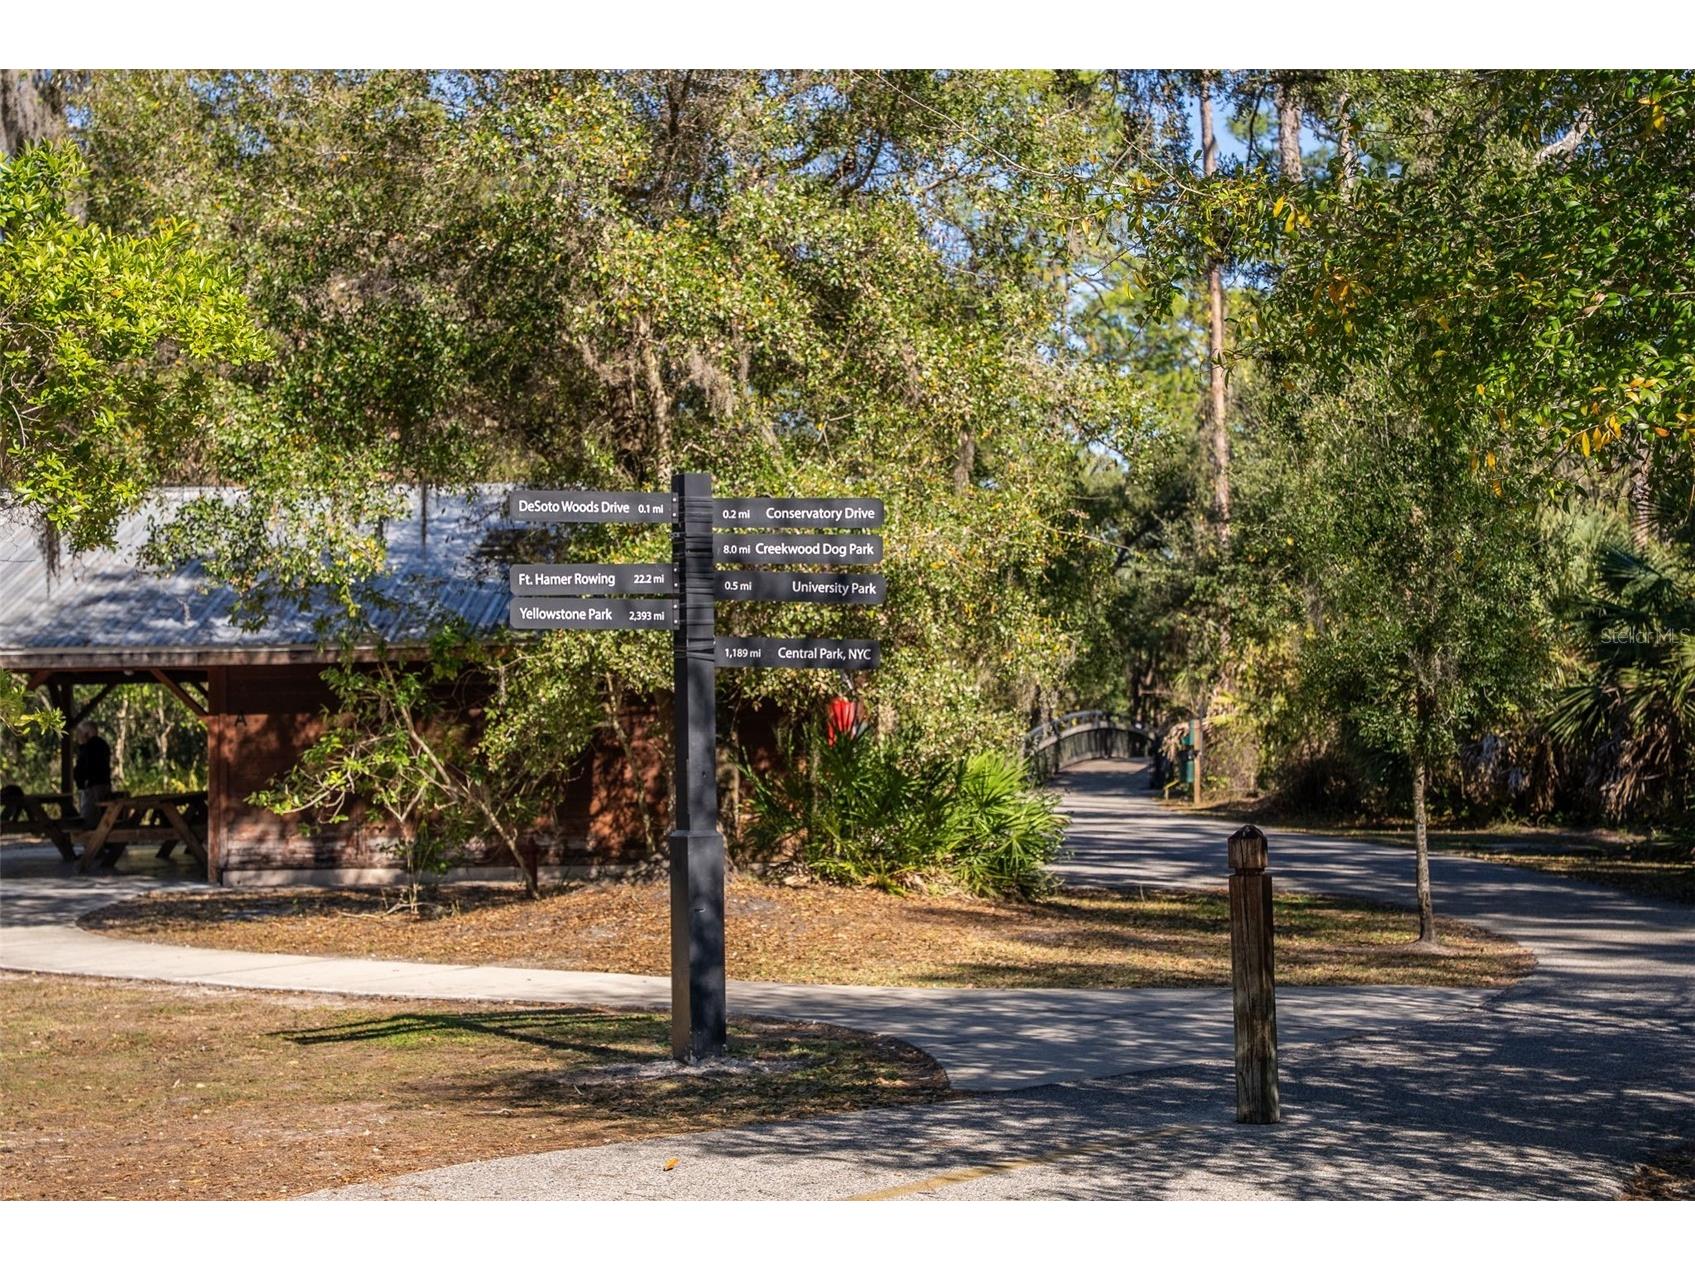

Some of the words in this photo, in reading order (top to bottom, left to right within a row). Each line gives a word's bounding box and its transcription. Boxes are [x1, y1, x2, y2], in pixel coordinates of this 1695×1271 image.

[518, 499, 561, 513] DeSoto
[560, 500, 600, 513] Woods
[600, 500, 630, 514] Drive
[637, 503, 651, 514] 0.1
[652, 503, 664, 514] mi
[722, 509, 737, 519] 0.2
[737, 509, 751, 519] mi
[765, 507, 843, 522] Conservatory
[844, 507, 876, 520] Drive
[722, 544, 738, 555] 8.0
[738, 544, 751, 555] mi
[755, 542, 821, 555] Creekwood
[822, 542, 847, 558] Dog
[849, 542, 875, 556] Park
[518, 573, 534, 586] Ft.
[534, 573, 573, 586] Hamer
[574, 572, 616, 587] Rowing
[633, 574, 652, 584] 22.2
[652, 573, 665, 584] mi
[724, 580, 739, 591] 0.5
[739, 581, 752, 591] mi
[792, 580, 850, 597] University
[851, 582, 877, 595] Park
[519, 607, 587, 621] Yellowstone
[588, 607, 613, 621] Park
[628, 610, 652, 622] 2,393
[653, 611, 665, 621] mi
[724, 647, 749, 659] 1,189
[749, 648, 762, 658] mi
[777, 646, 818, 659] Central
[819, 647, 847, 661] Park,
[848, 648, 871, 660] NYC
